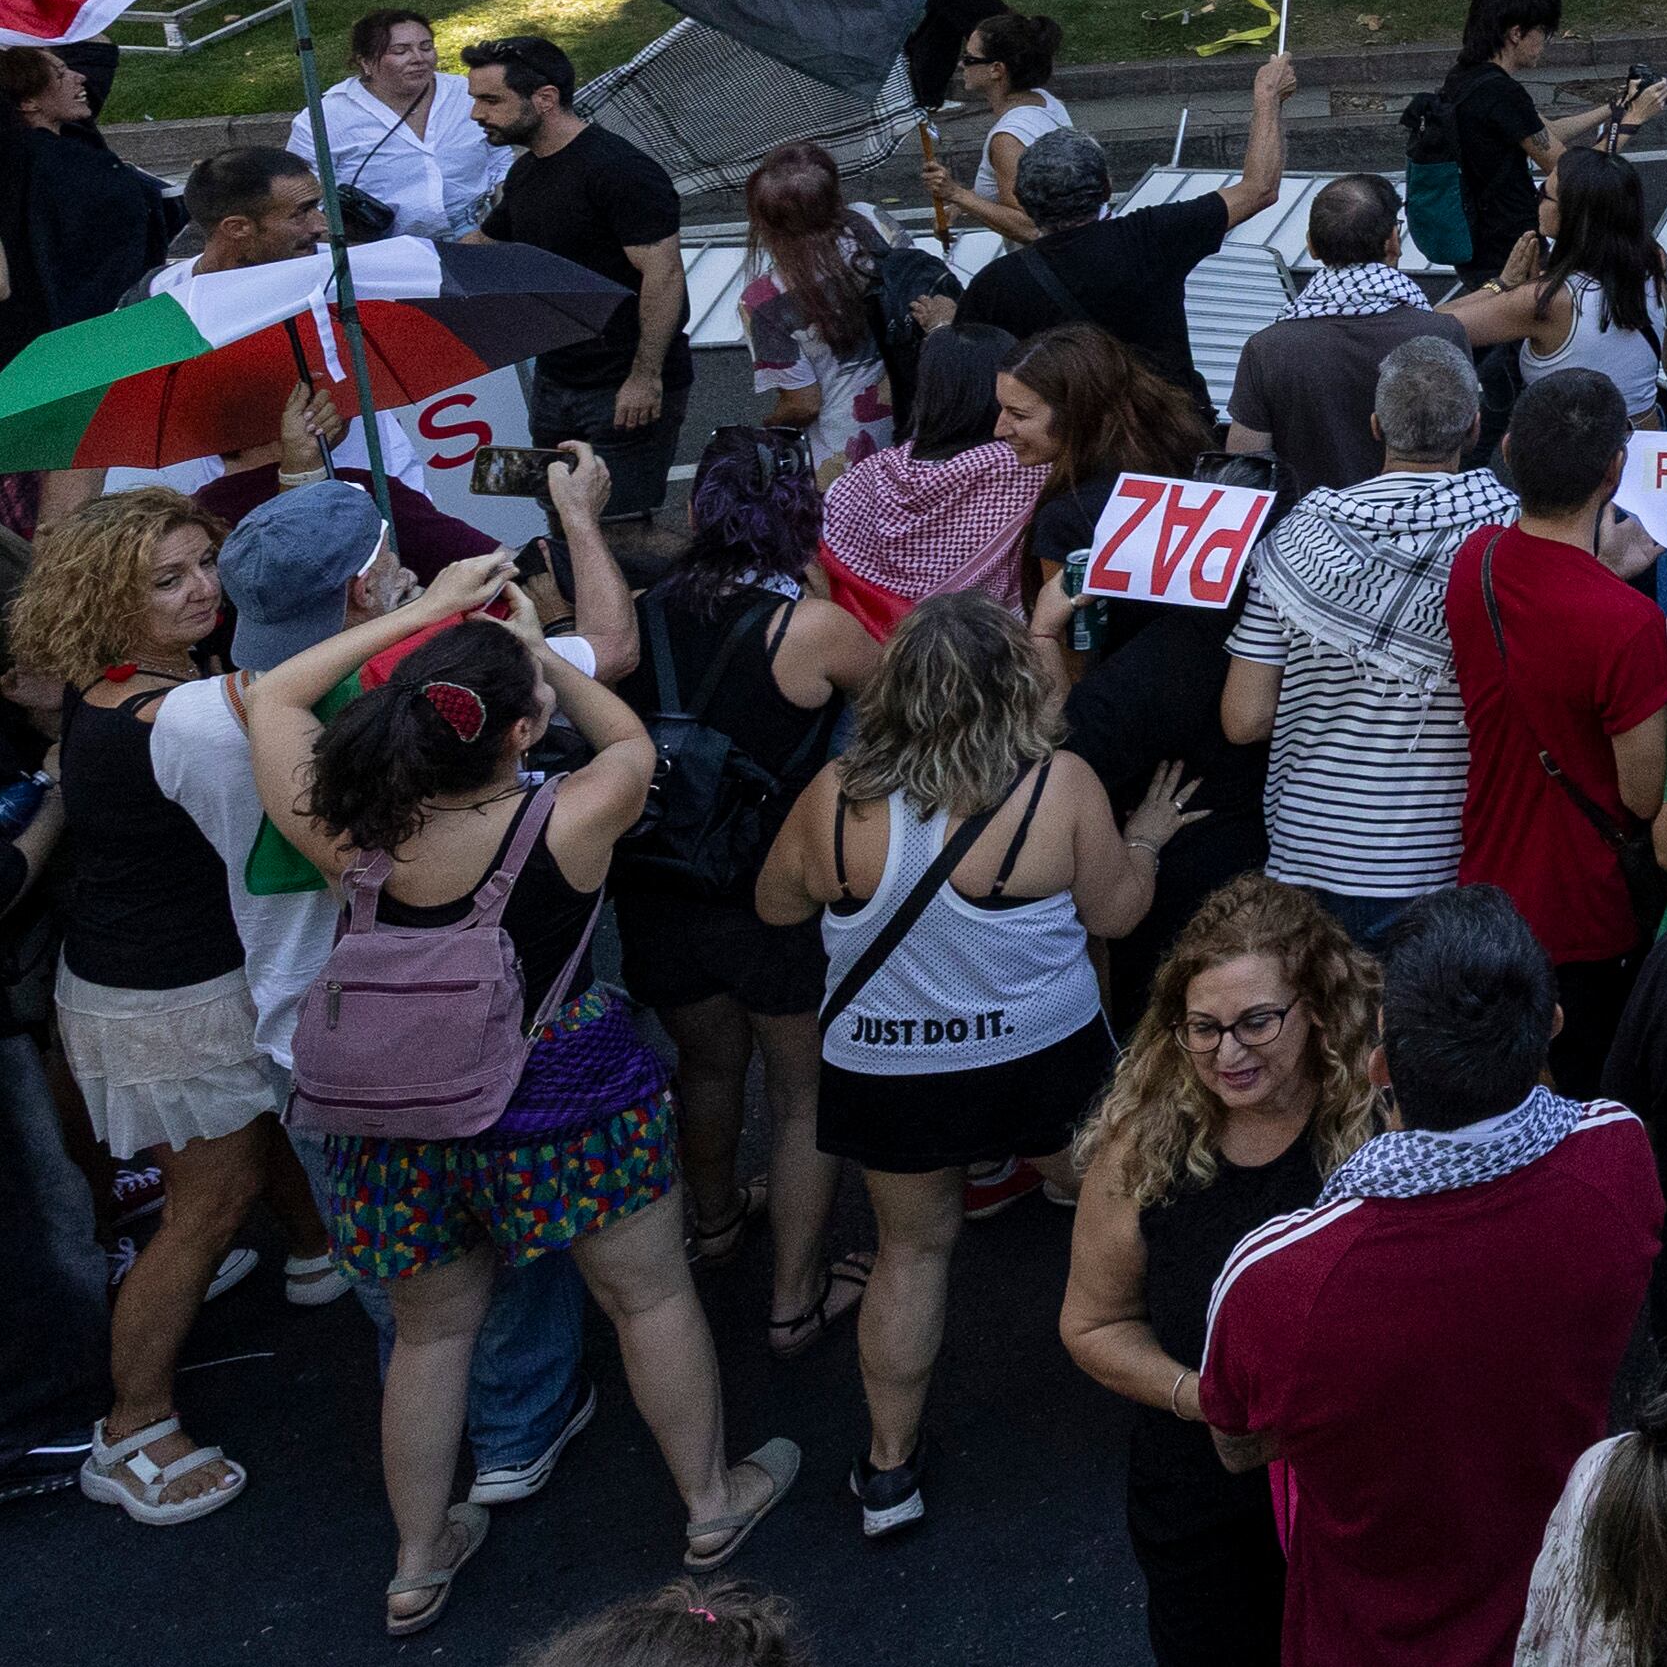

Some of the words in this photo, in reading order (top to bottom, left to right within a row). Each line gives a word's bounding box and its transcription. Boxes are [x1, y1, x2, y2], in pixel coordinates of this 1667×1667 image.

[1088, 478, 1270, 603] PAZ
[851, 1015, 917, 1045] JUST
[924, 1018, 969, 1045] DO
[975, 1009, 1015, 1040] IT.
